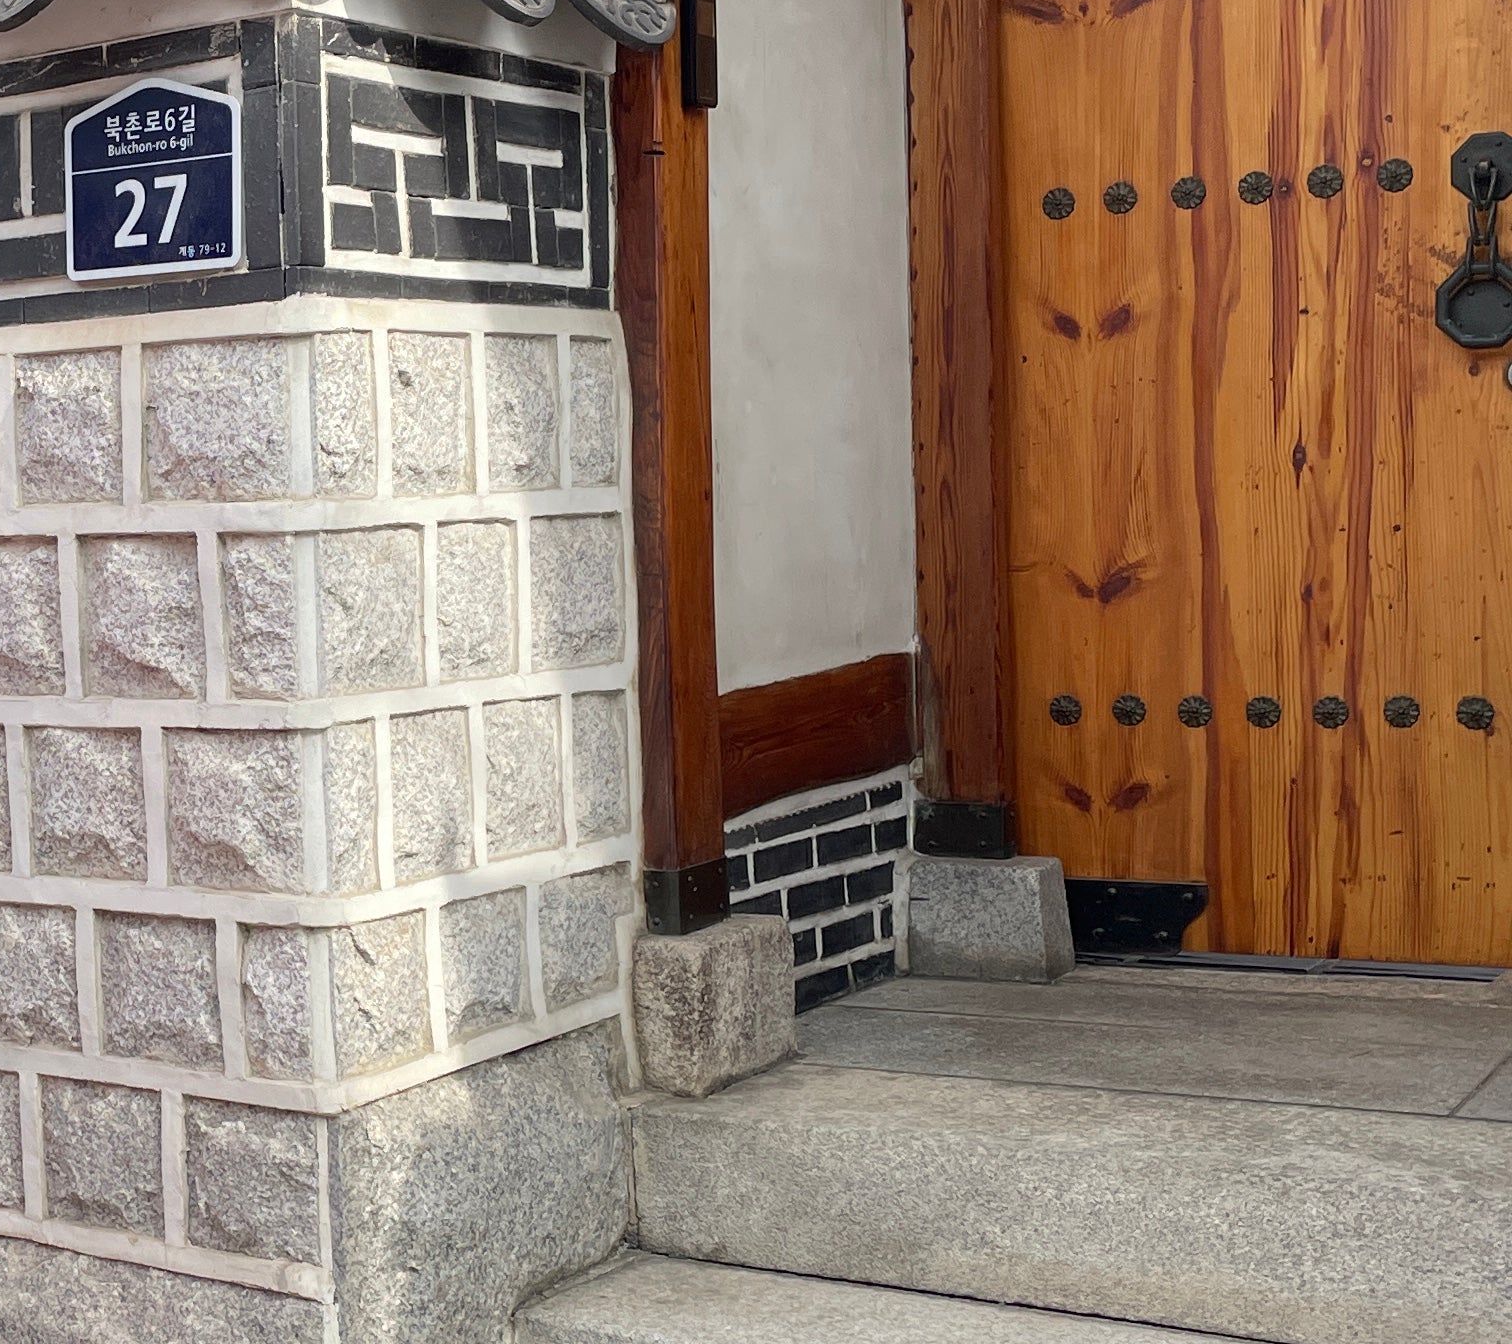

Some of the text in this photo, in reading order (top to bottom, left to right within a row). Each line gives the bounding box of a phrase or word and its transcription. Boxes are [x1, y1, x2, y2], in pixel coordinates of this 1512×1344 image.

[104, 103, 196, 143] 북촌로6길
[107, 133, 194, 157] Bukchon-ro 6-gil
[114, 173, 188, 248] 27
[178, 242, 226, 258] 계동 79-12
